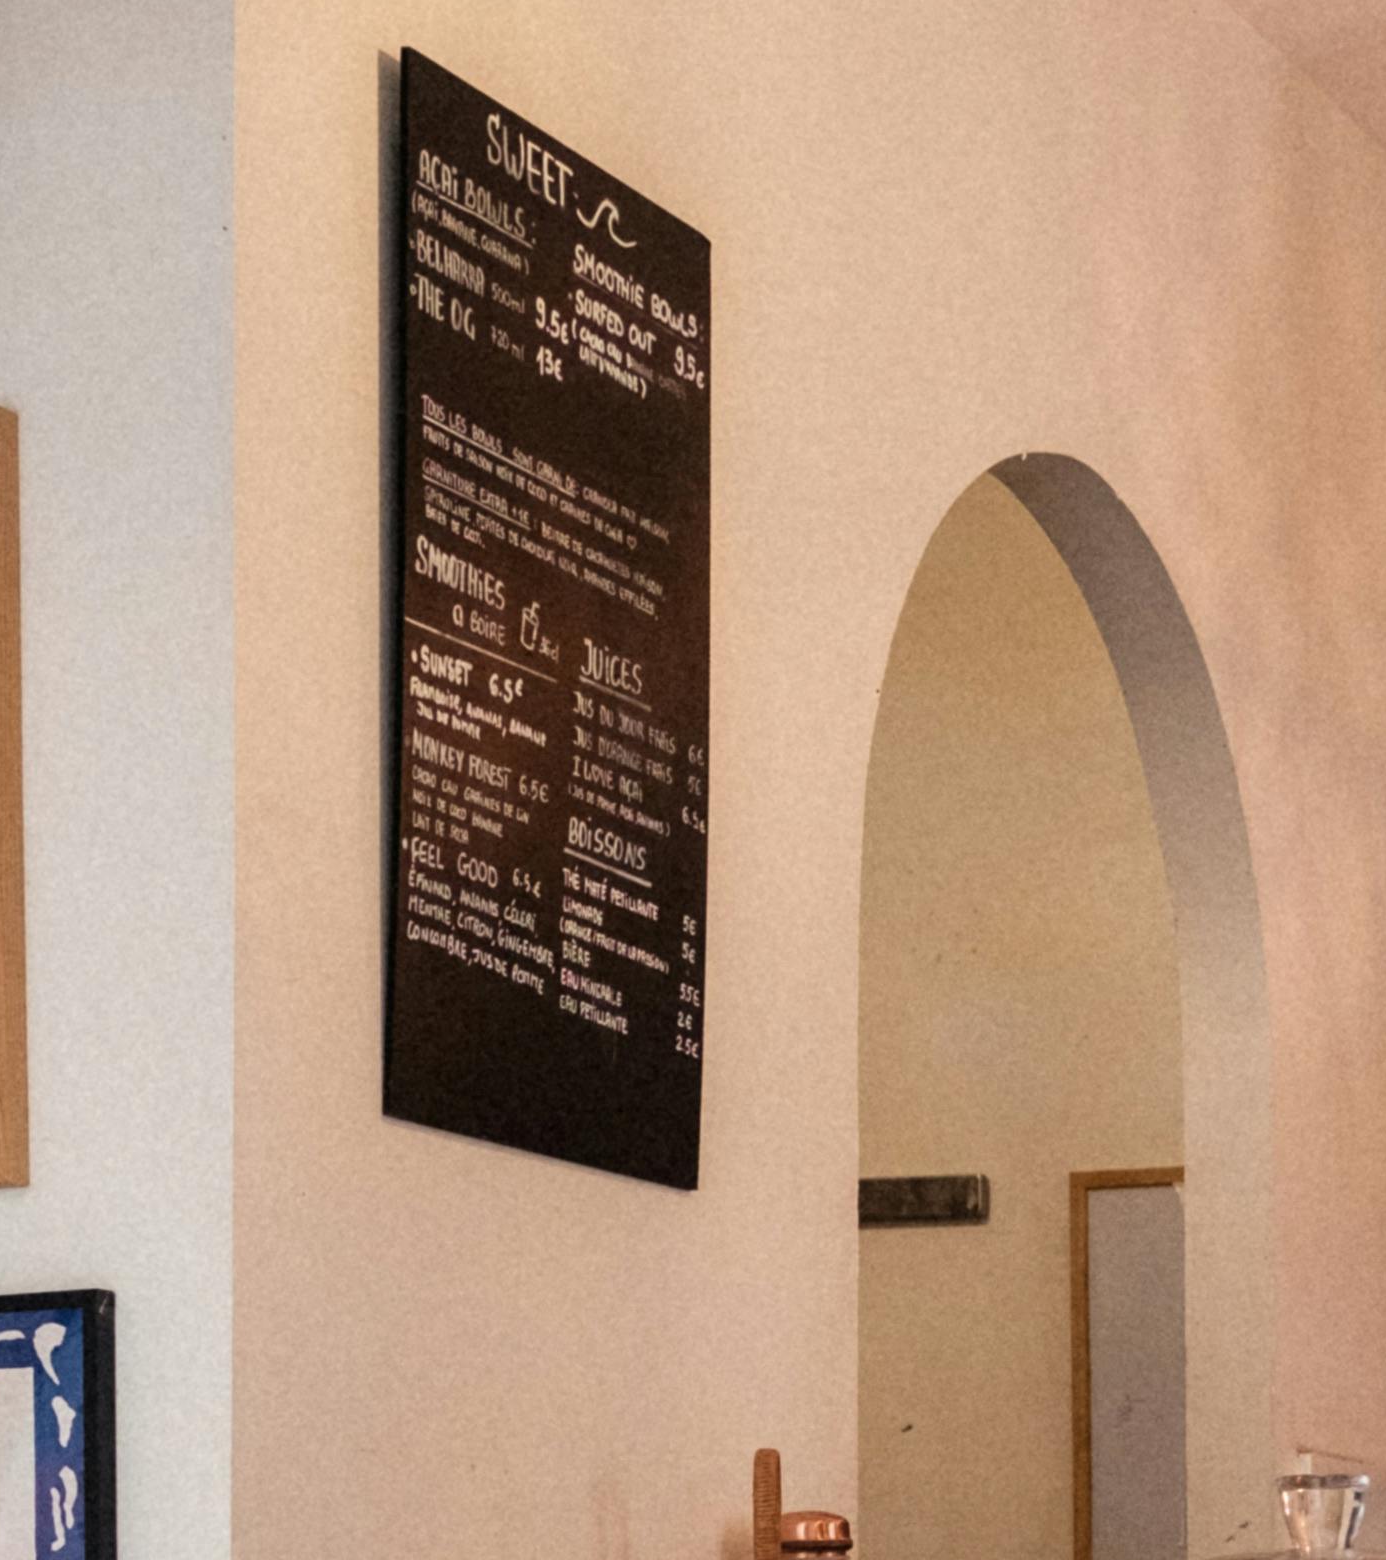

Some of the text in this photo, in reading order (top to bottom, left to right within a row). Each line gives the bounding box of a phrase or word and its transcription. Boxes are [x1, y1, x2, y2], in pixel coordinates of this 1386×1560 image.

[487, 113, 574, 208] SWEET
[414, 272, 445, 322] THE
[411, 837, 445, 870] FEEL
[457, 852, 498, 888] GOOD
